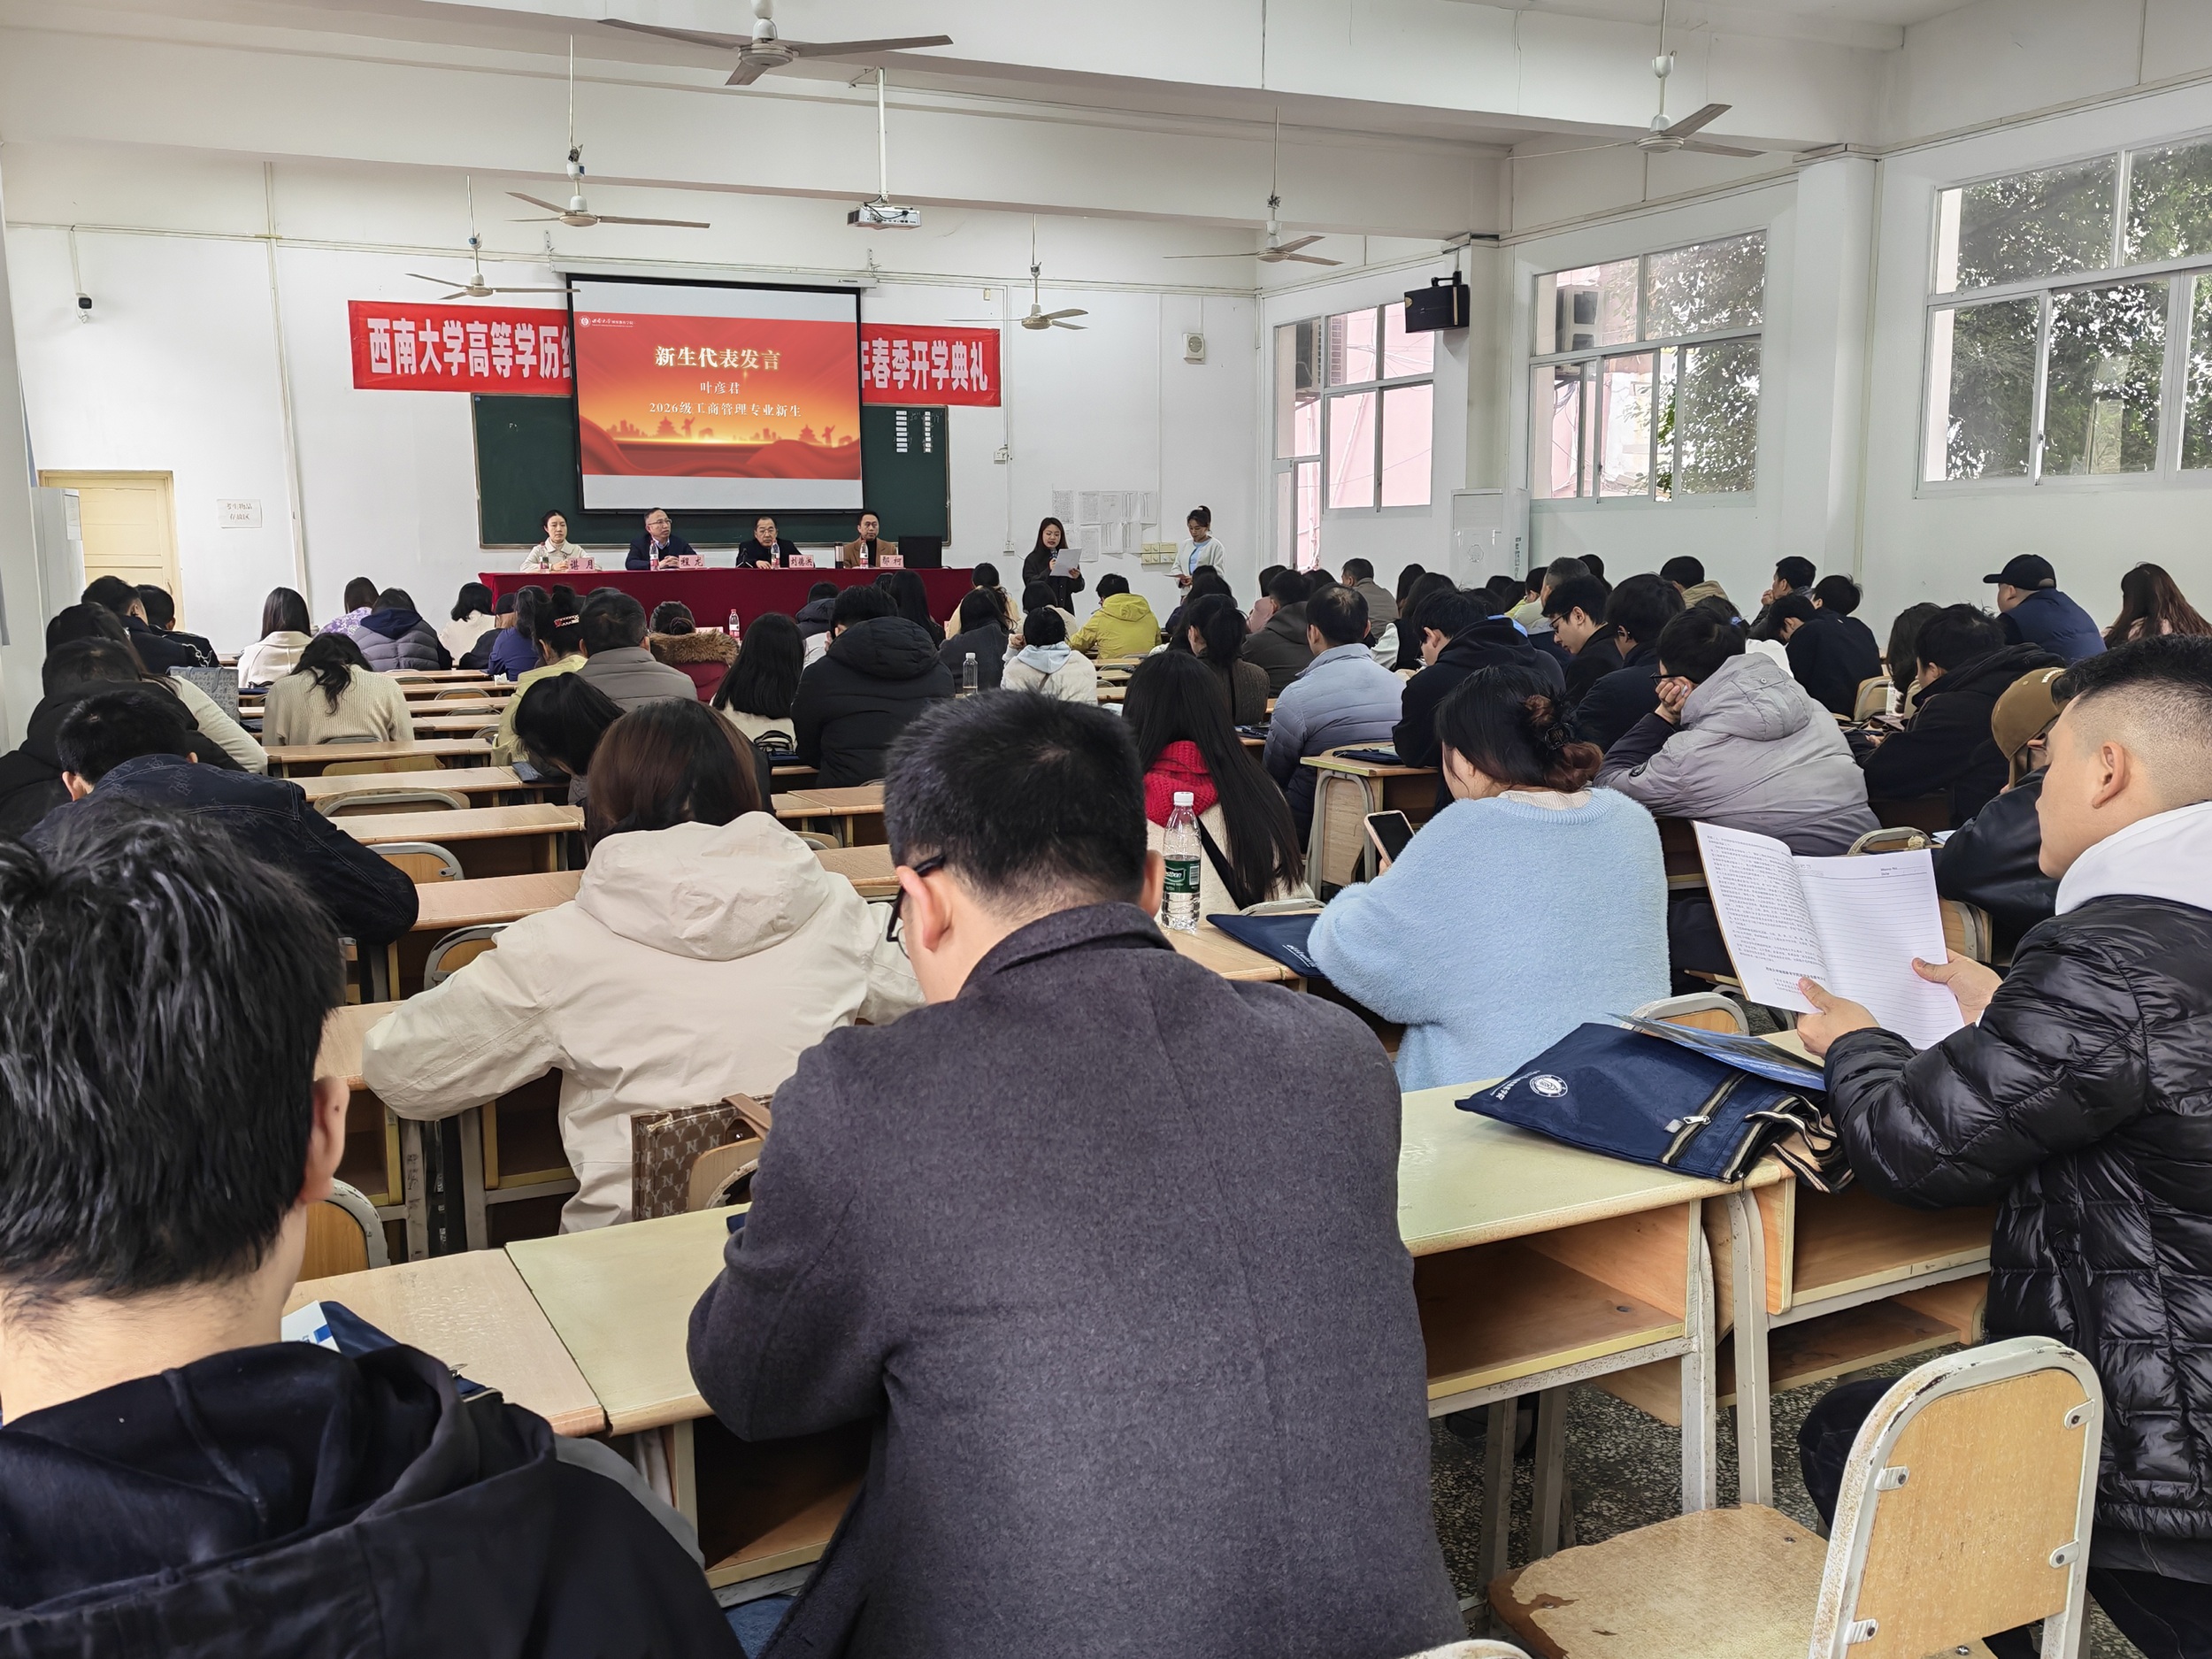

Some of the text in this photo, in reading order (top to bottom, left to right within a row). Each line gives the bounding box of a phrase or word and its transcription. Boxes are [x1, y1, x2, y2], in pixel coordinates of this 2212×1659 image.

[655, 346, 780, 370] 新生代表发言
[700, 381, 740, 394] 叶彦君
[649, 402, 802, 417] 2026级工商管理专业新生
